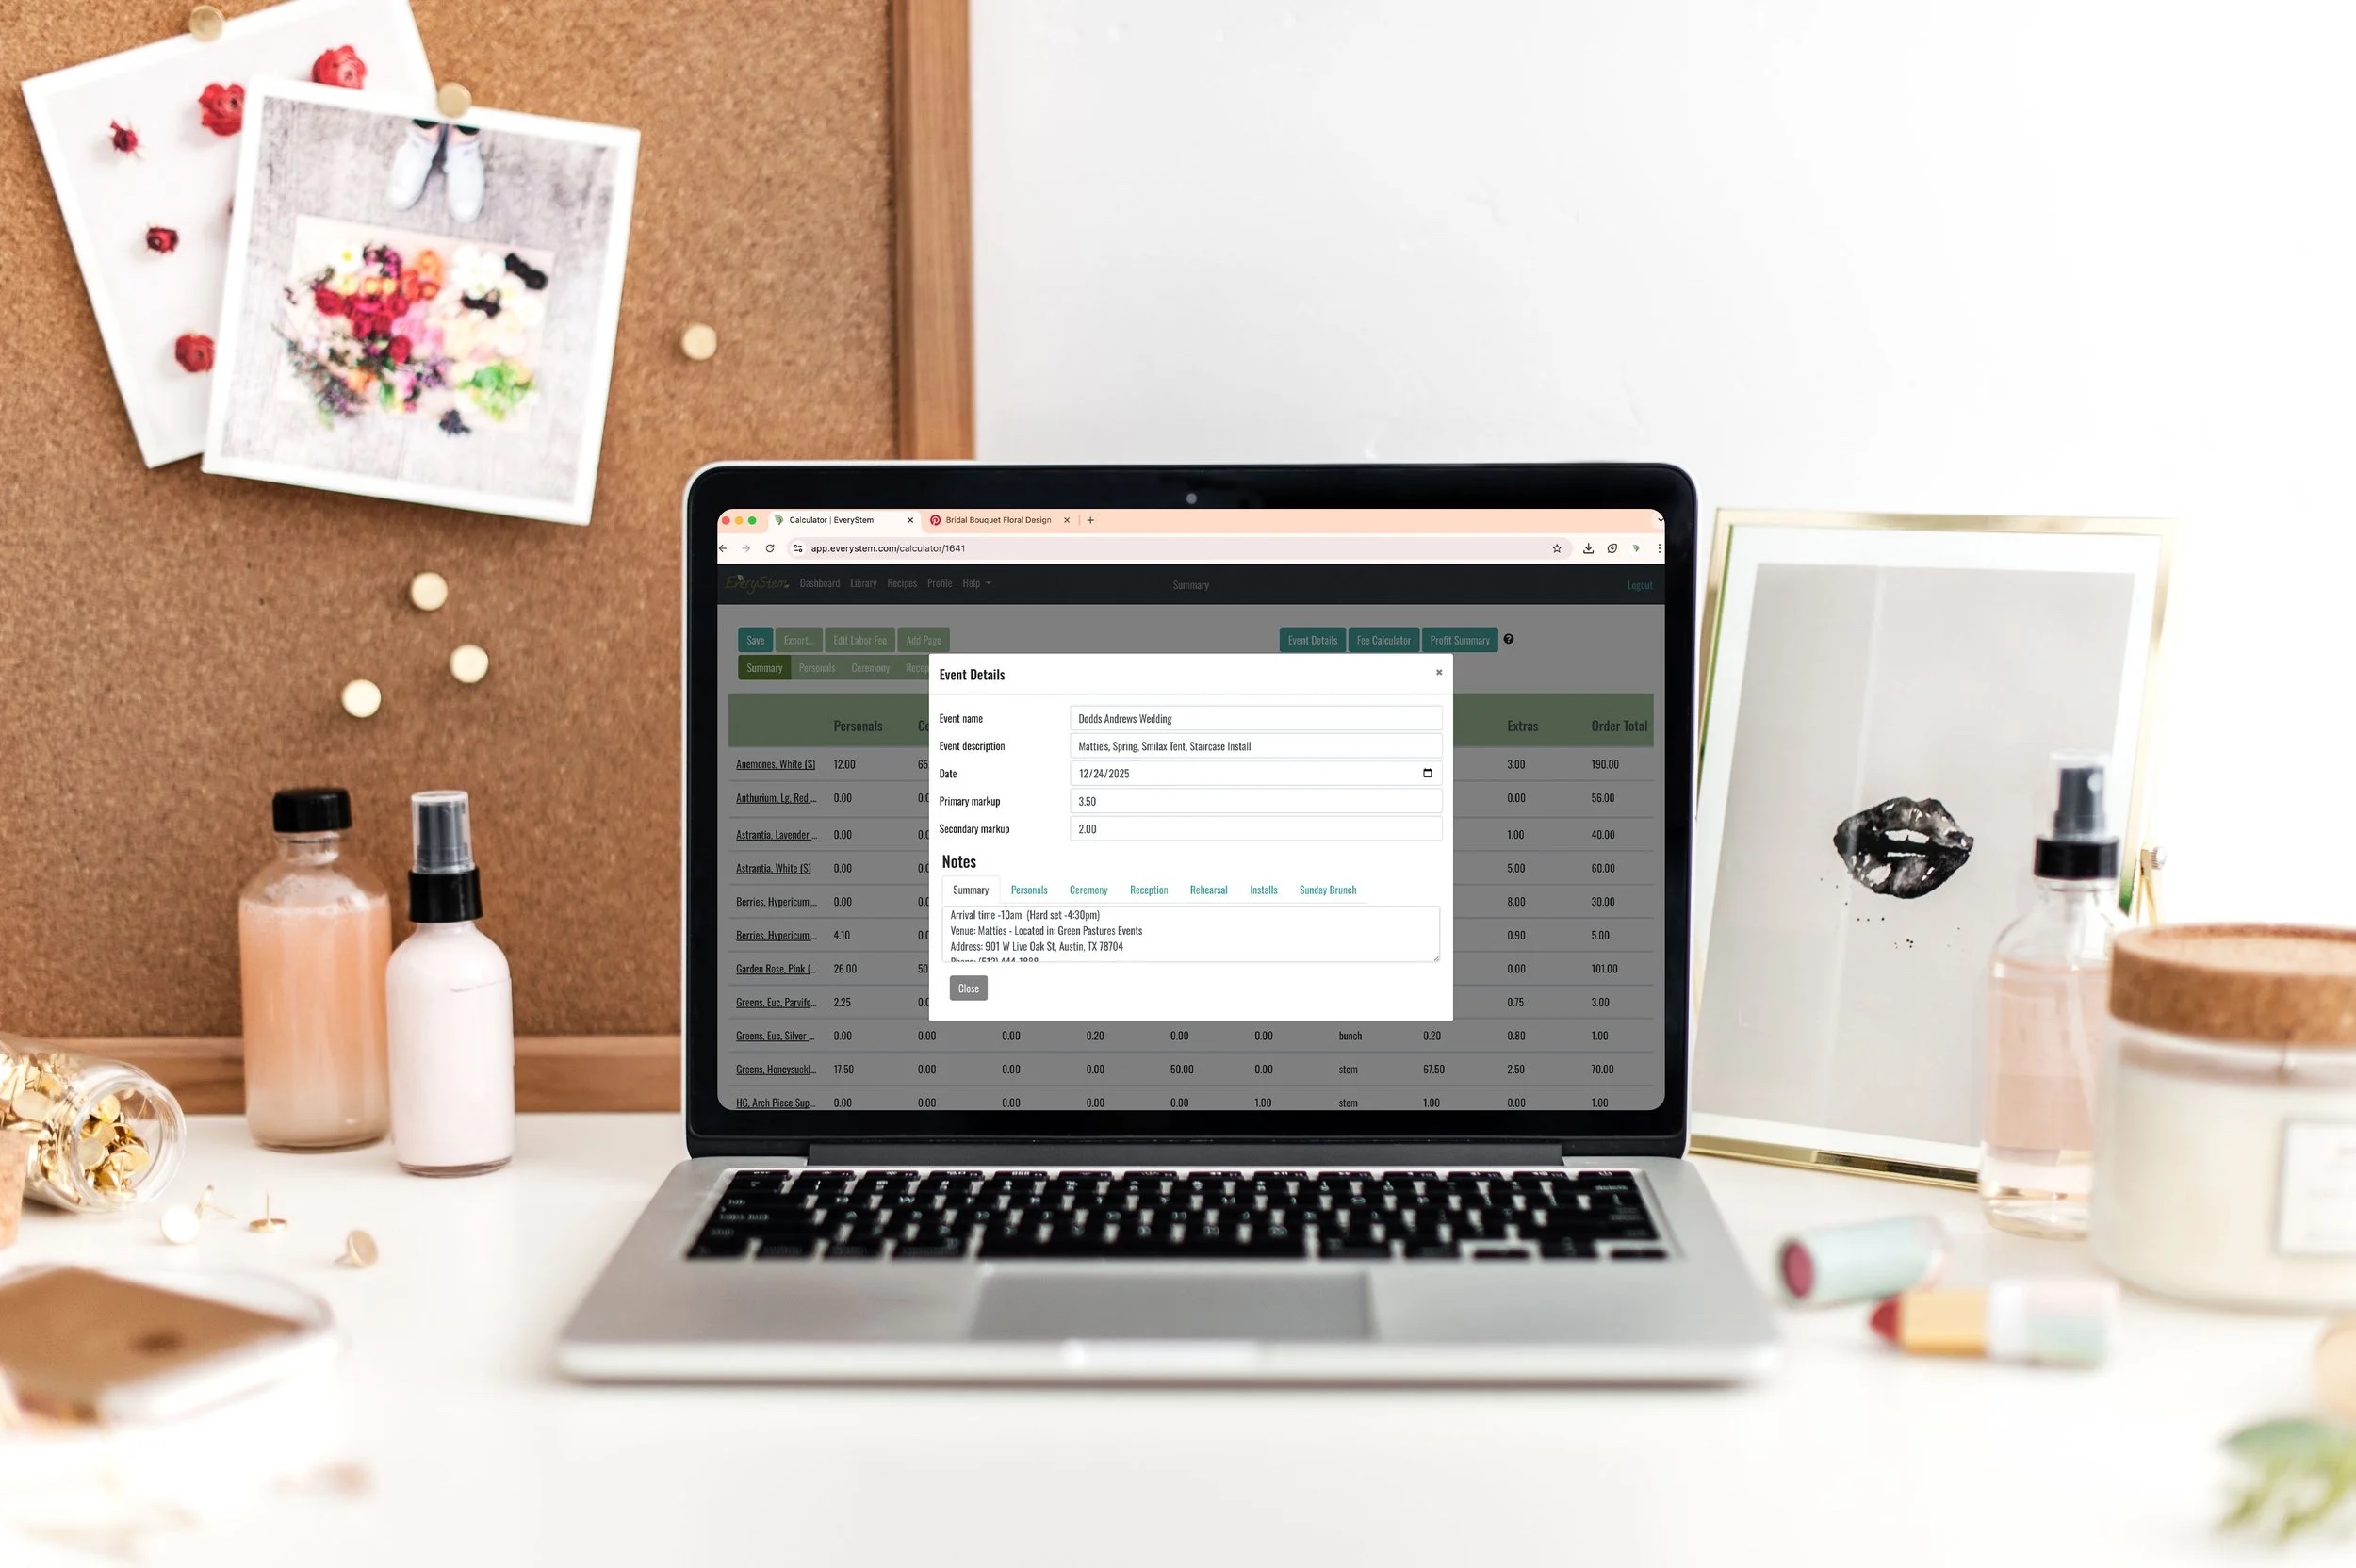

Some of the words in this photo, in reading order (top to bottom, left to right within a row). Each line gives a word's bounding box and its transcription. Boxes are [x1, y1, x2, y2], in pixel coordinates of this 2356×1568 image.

[790, 515, 828, 525] Calculator
[833, 515, 875, 526] EveryStem
[946, 515, 968, 525] Bridal
[970, 515, 1000, 526] Bouquet
[1003, 515, 1023, 525] Floral
[1026, 515, 1052, 526] Design
[811, 544, 966, 555] app.everystem.com/calculator/1641
[800, 579, 841, 588] Dashboard
[851, 579, 877, 590] Library
[888, 579, 918, 590] Recipes
[928, 579, 953, 588] Profile
[963, 579, 981, 590] Help
[1173, 580, 1210, 592] Summary
[1628, 580, 1654, 592] Logout
[747, 636, 765, 645] Save
[834, 636, 848, 645] Edit
[851, 636, 872, 645] Labor
[875, 636, 888, 645] Fee
[907, 636, 922, 645] Add
[924, 636, 941, 647] Page
[1288, 635, 1311, 645] Event
[1313, 635, 1338, 645] Details
[1357, 635, 1369, 645] Fee
[1372, 635, 1412, 645] Calculator
[1431, 635, 1451, 645] Profit
[1454, 635, 1491, 647] Summary
[747, 663, 783, 674] Summary
[799, 663, 836, 673] Personals
[852, 663, 891, 674] Ceremony
[940, 669, 967, 680] Event
[971, 669, 1006, 680] Details
[940, 713, 960, 724] Event
[962, 713, 984, 724] name
[1079, 714, 1103, 724] Dodds
[1104, 714, 1137, 724] Andrews
[1139, 714, 1172, 726] Wedding
[834, 721, 883, 732] Personals
[1508, 720, 1539, 732] Extras
[1592, 720, 1621, 732] Order
[1624, 720, 1648, 732] Total
[940, 742, 960, 751] Event
[962, 742, 1006, 753] description
[1079, 742, 1111, 753] Mattie's,
[1113, 742, 1139, 754] Spring,
[1142, 742, 1168, 752] Smilax
[1170, 742, 1188, 753] Tent,
[1190, 742, 1226, 752] Staircase
[1228, 742, 1252, 752] Install
[780, 760, 803, 771] White
[805, 760, 816, 771] (S)
[833, 760, 856, 769] 12.00
[1508, 760, 1526, 769] 3.00
[1591, 760, 1619, 769] 190.00
[940, 769, 957, 778] Date
[1079, 769, 1130, 779] 12/24/2025
[794, 793, 809, 805] Red
[940, 797, 970, 808] Primary
[972, 797, 1001, 808] markup
[1079, 797, 1097, 807] 3.50
[1591, 793, 1615, 803] 56.00
[940, 825, 979, 836] Secondary
[981, 825, 1010, 836] markup
[1079, 825, 1097, 834] 2.00
[1508, 829, 1525, 840] 1.00
[1591, 829, 1615, 840] 40.00
[776, 829, 810, 841] Lavender
[942, 856, 977, 869] Notes
[776, 863, 798, 874] White
[800, 863, 811, 874] (S)
[1508, 863, 1526, 874] 5.00
[1591, 863, 1615, 874] 60.00
[953, 885, 990, 897] Summary
[1011, 885, 1048, 895] Personals
[1070, 885, 1108, 897] Ceremony
[1131, 885, 1169, 897] Reception
[1190, 885, 1228, 895] Rehearsal
[1251, 885, 1278, 895] Installs
[1300, 885, 1328, 897] Sunday
[1330, 885, 1357, 895] Brunch
[1508, 897, 1526, 906] 8.00
[1591, 897, 1615, 906] 30.00
[951, 910, 976, 920] Arrival
[978, 910, 996, 920] time
[998, 910, 1023, 920] -10am
[1026, 910, 1048, 921] (Hard
[1050, 910, 1062, 920] set
[1064, 910, 1101, 922] -4:30pm)
[833, 930, 850, 940] 4.10
[951, 926, 976, 936] Venue:
[978, 926, 1007, 936] Matties
[1015, 926, 1044, 936] Located
[1047, 926, 1056, 936] in:
[1057, 926, 1081, 936] Green
[1083, 926, 1116, 936] Pastures
[1118, 926, 1143, 936] Events
[1508, 930, 1526, 940] 0.90
[1591, 930, 1610, 940] 5.00
[951, 941, 984, 952] Address:
[985, 941, 1000, 952] 901
[1002, 941, 1010, 952] W
[1012, 941, 1028, 952] Live
[1030, 941, 1045, 952] Oak
[1047, 941, 1057, 953] St,
[1059, 941, 1086, 953] Austin,
[1088, 941, 1097, 952] TX
[1100, 941, 1123, 952] 78704
[736, 963, 763, 974] Garden
[789, 963, 806, 974] Pink
[833, 963, 857, 973] 26.00
[1591, 963, 1618, 973] 101.00
[958, 984, 980, 994] Close
[833, 997, 851, 1007] 2.25
[1508, 997, 1525, 1007] 0.75
[1591, 997, 1610, 1007] 3.00
[785, 1031, 807, 1042] Silver
[1339, 1031, 1363, 1040] bunch
[1508, 1031, 1526, 1040] 0.80
[1591, 1031, 1609, 1040] 1.00
[833, 1064, 854, 1074] 17.50
[1170, 1064, 1194, 1074] 50.00
[1339, 1064, 1358, 1074] stem
[1423, 1064, 1446, 1074] 67.50
[1508, 1064, 1525, 1074] 2.50
[1591, 1064, 1614, 1074] 70.00
[753, 1097, 770, 1108] Arch
[772, 1097, 792, 1108] Piece
[1339, 1097, 1358, 1107] stem
[1423, 1097, 1440, 1107] 1.00
[1591, 1097, 1609, 1107] 1.00
